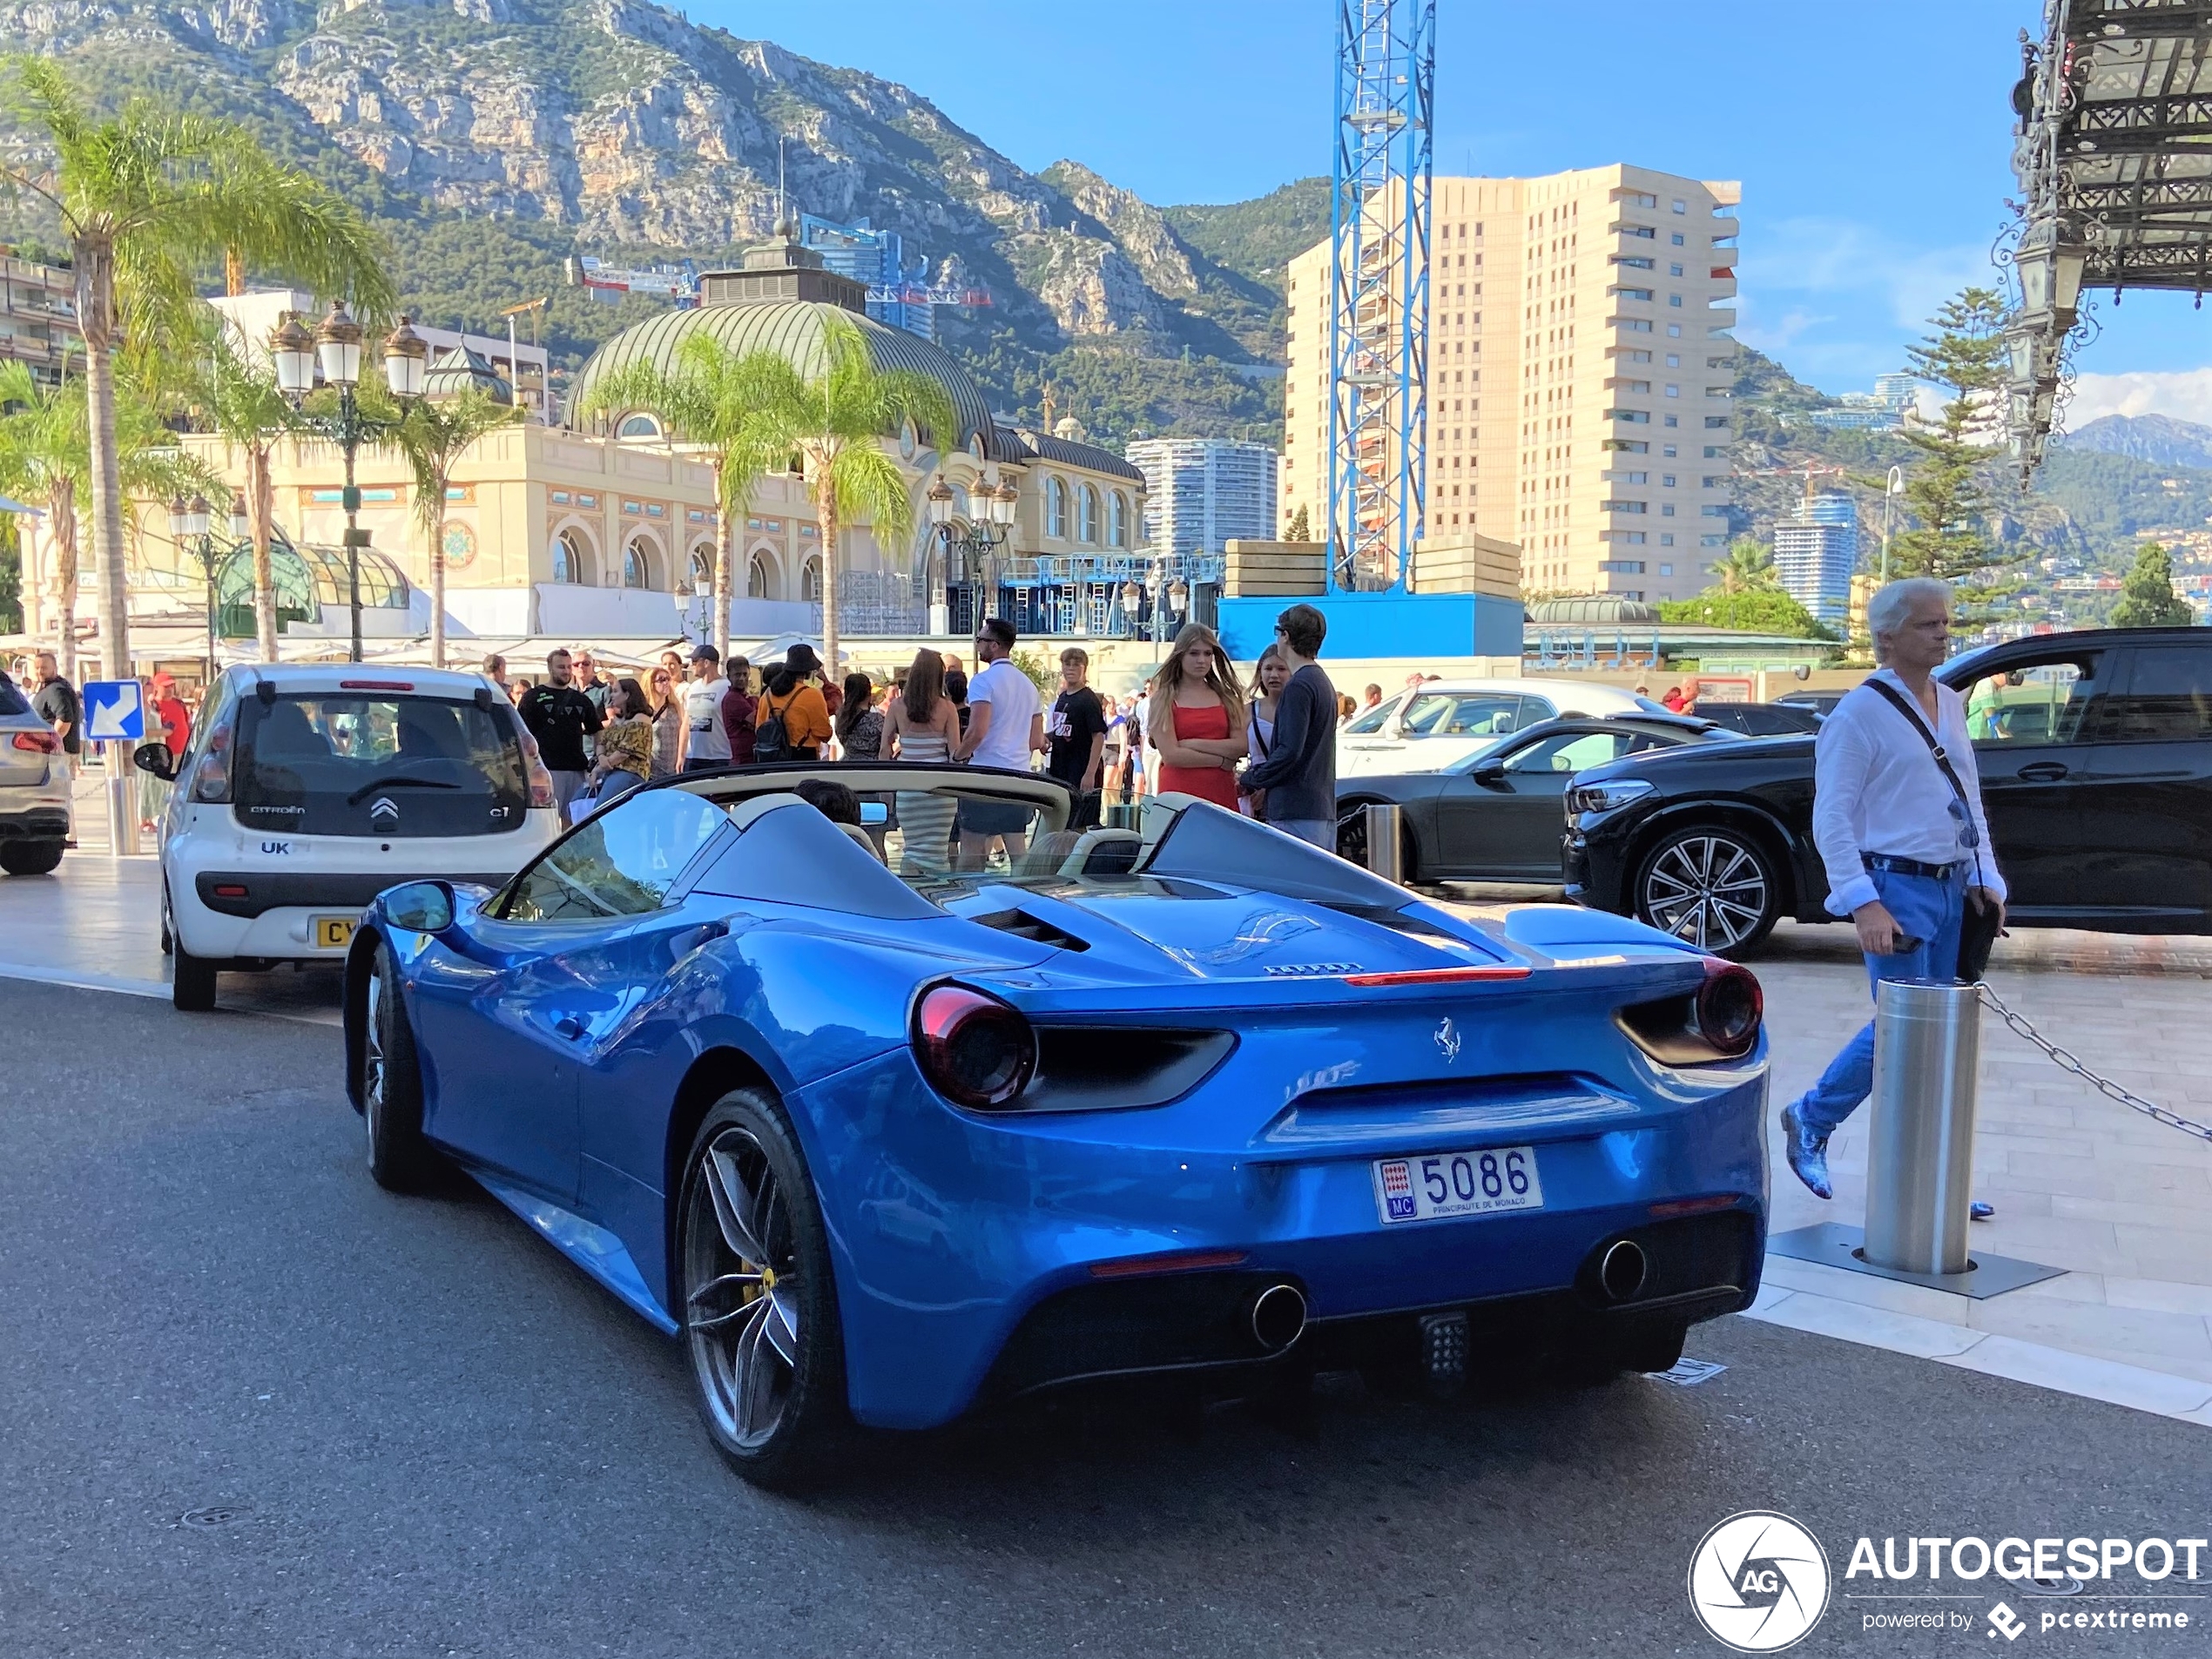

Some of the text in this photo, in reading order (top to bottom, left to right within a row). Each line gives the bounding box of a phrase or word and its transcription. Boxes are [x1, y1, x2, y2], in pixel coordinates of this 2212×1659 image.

[261, 841, 289, 854] UK
[1421, 1150, 1529, 1204] 5086
[1393, 1199, 1412, 1215] MC
[1494, 1197, 1526, 1208] MONACO
